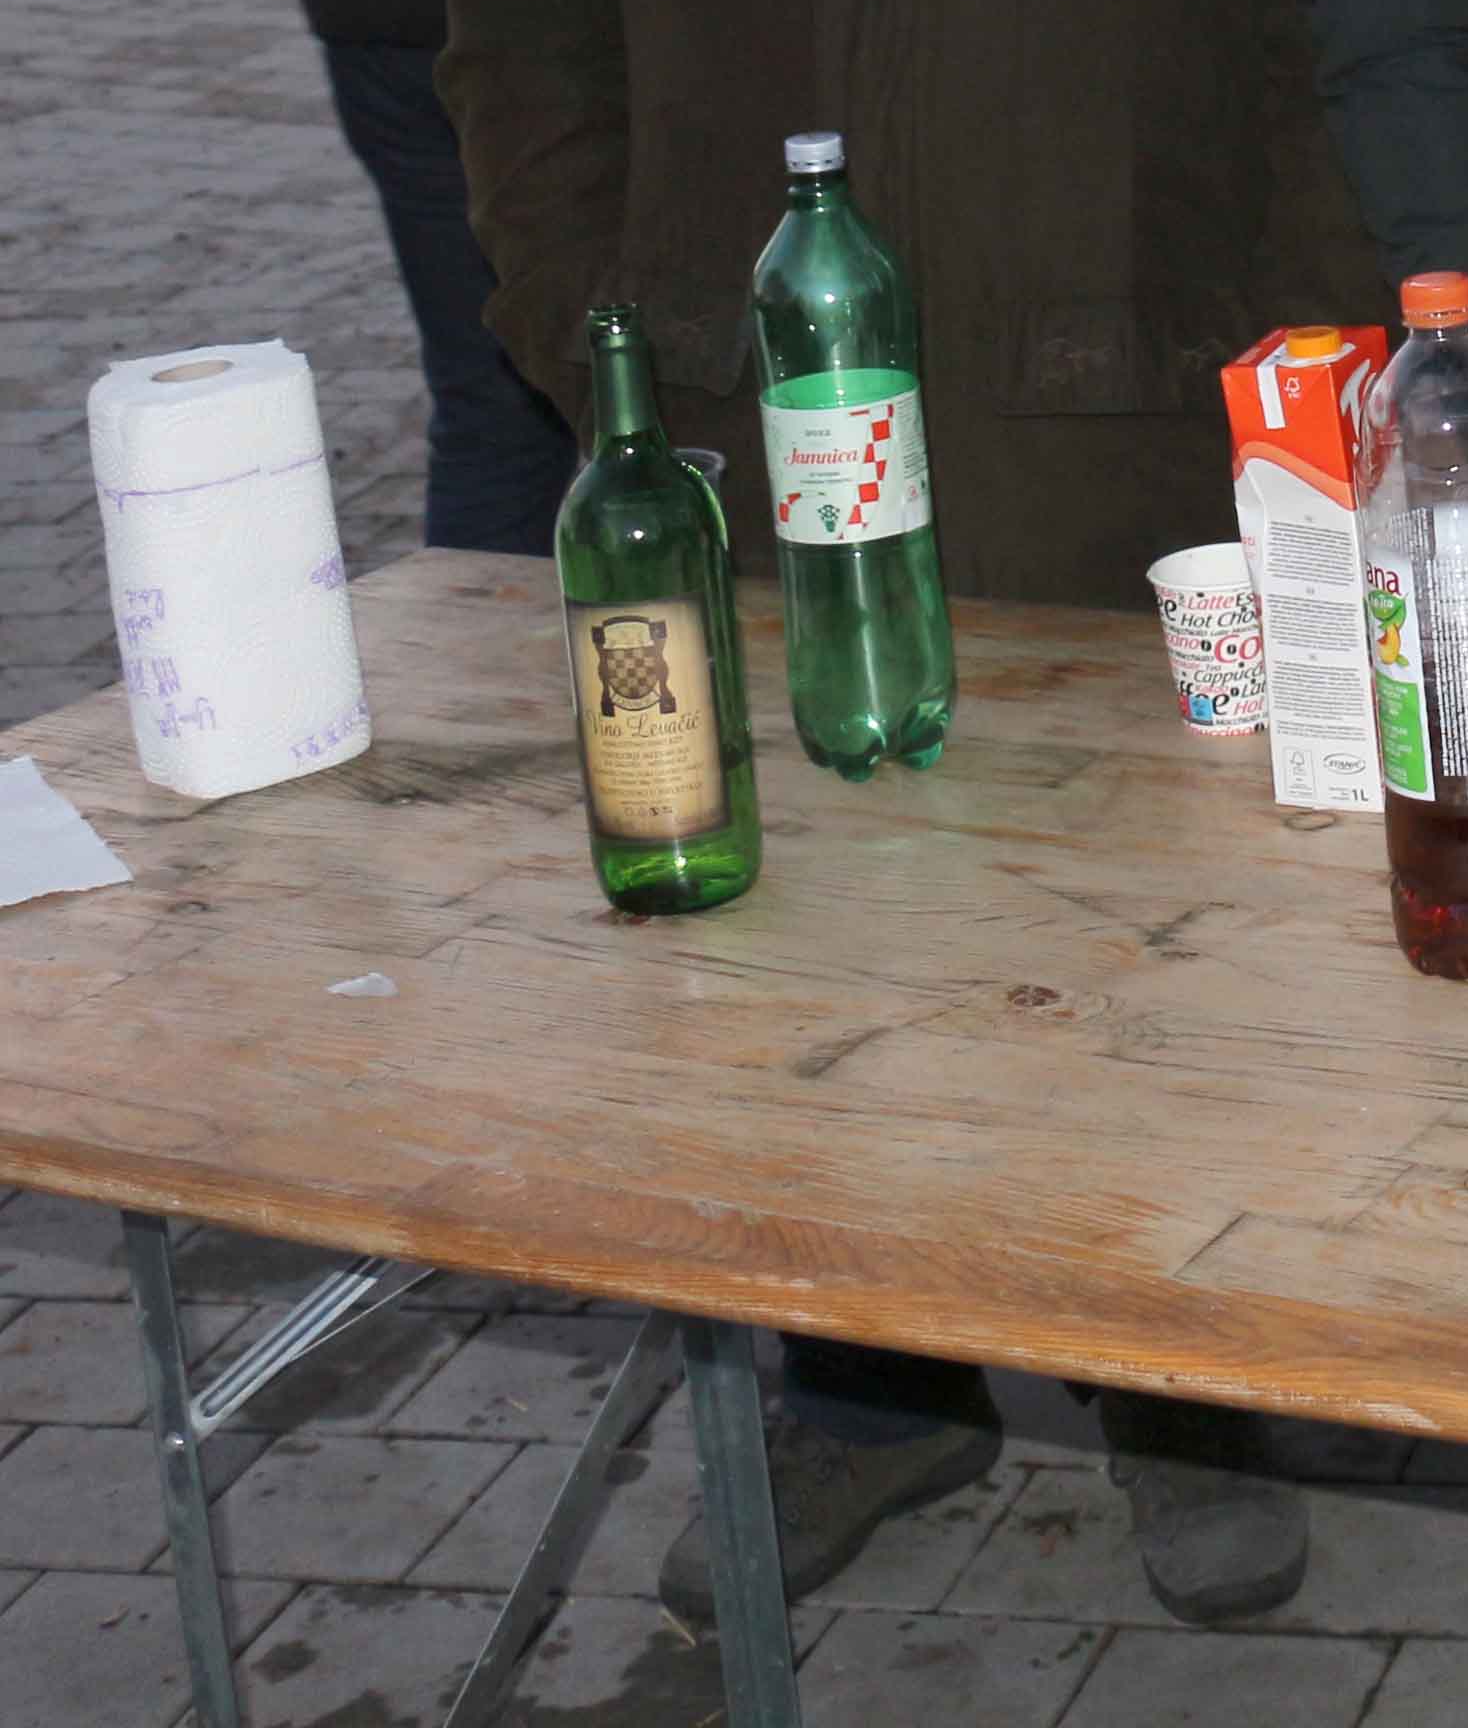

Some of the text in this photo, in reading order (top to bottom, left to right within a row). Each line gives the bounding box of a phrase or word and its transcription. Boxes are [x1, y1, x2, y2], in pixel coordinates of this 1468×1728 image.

[784, 448, 858, 464] Jamnica
[1187, 594, 1234, 610] Latte
[1181, 613, 1211, 628] Hot
[588, 712, 622, 737] Vino
